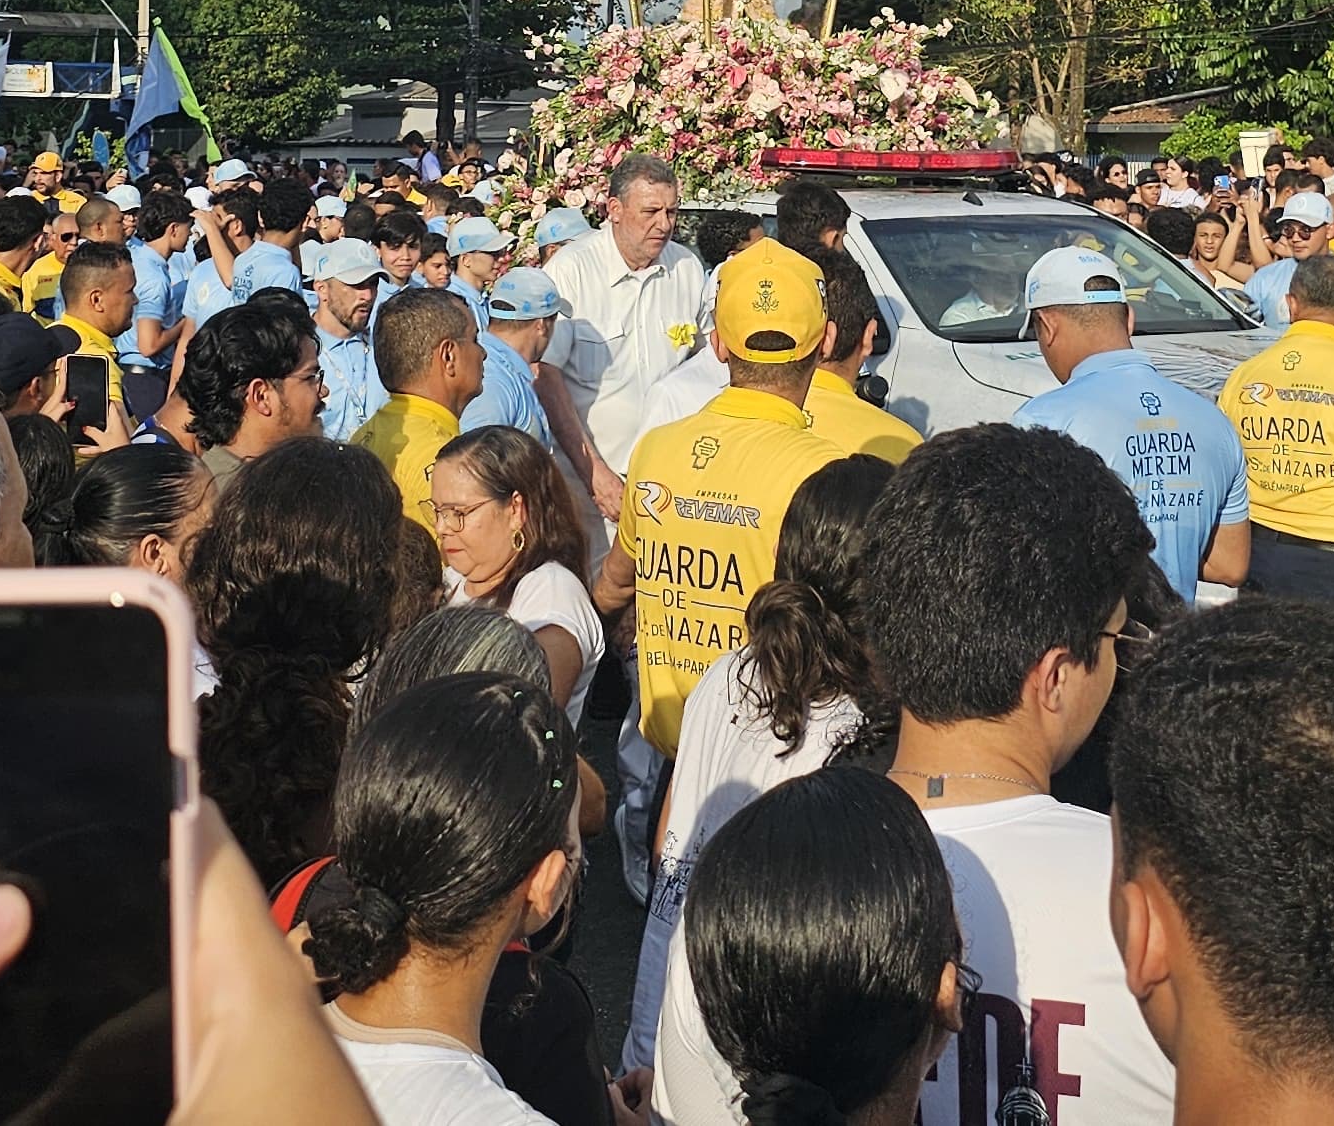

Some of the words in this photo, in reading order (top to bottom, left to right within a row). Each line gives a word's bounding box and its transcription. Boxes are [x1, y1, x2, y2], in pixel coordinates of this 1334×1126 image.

[1241, 416, 1327, 446] GUARDA
[1125, 432, 1196, 457] GUARDA
[1272, 443, 1291, 456] DE
[1132, 455, 1191, 479] MIRIM
[695, 489, 739, 501] EMPRESAS
[1151, 479, 1164, 491] DE
[1151, 490, 1204, 507] NAZARÉ
[673, 496, 761, 529] REVEMAR
[635, 536, 745, 596] GUARDA
[662, 588, 687, 610] DE
[664, 613, 743, 651] NAZAR
